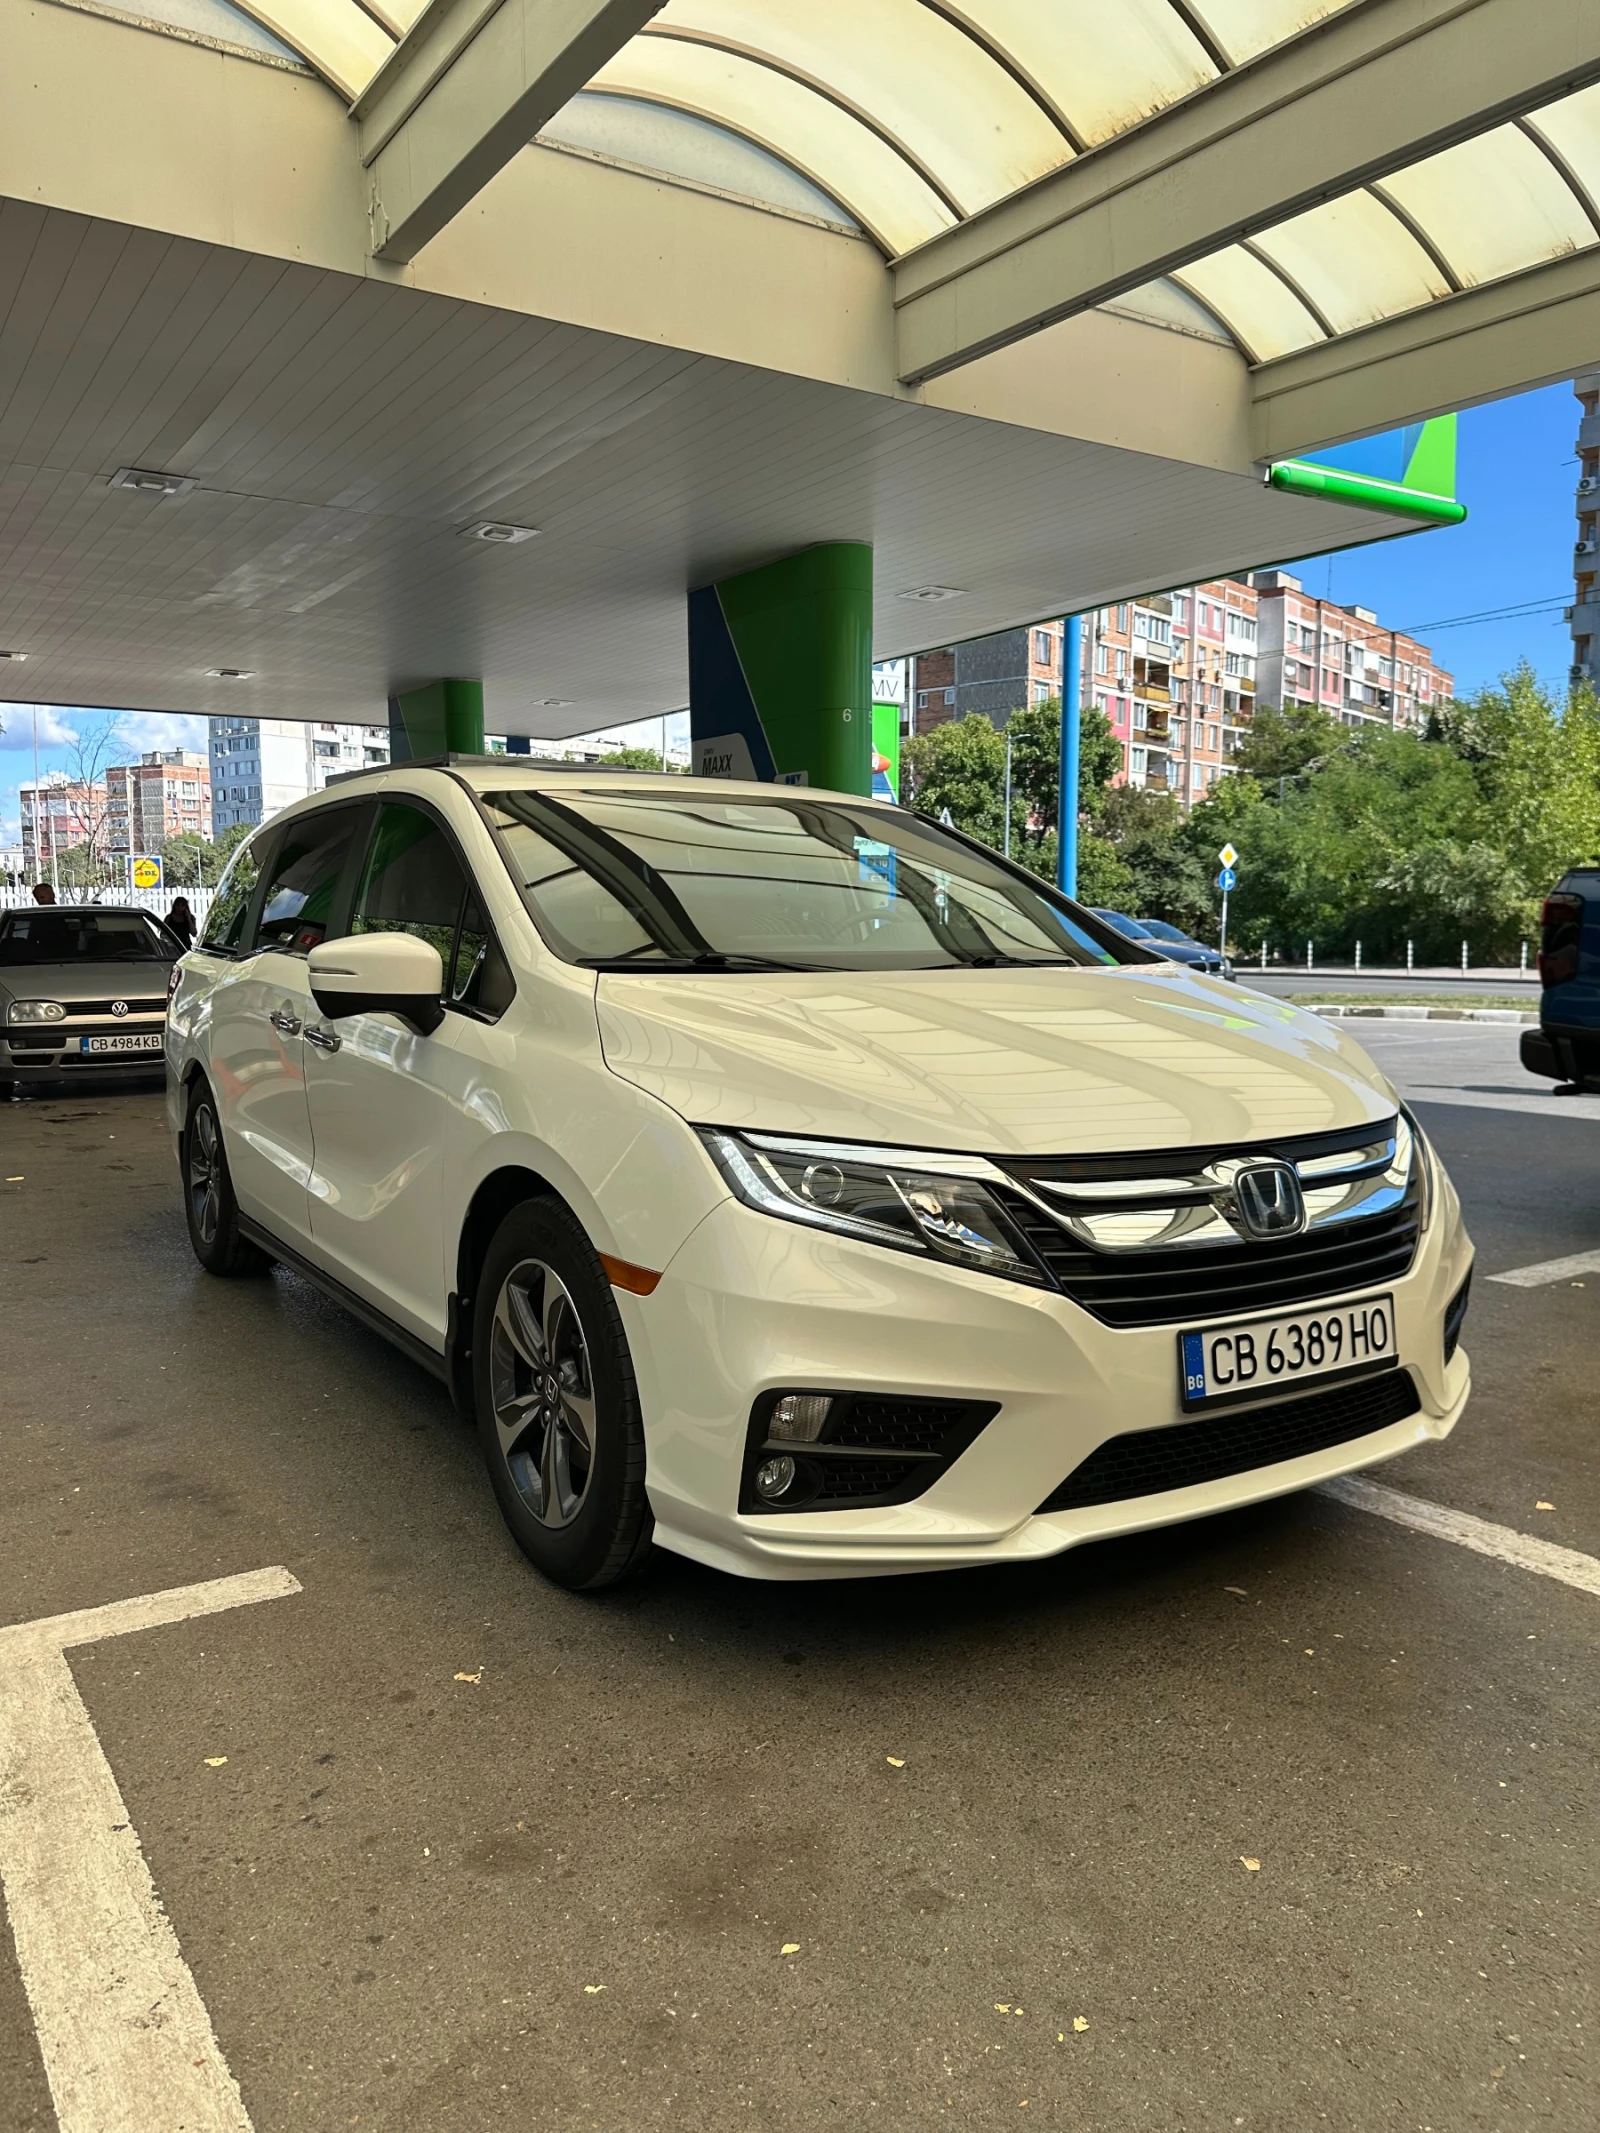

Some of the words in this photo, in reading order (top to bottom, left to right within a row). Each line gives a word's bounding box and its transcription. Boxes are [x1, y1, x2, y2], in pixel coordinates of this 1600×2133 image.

[872, 679, 898, 697] MV
[842, 708, 852, 723] 6
[702, 754, 732, 775] MAXX
[91, 1039, 108, 1051] CB
[111, 1037, 141, 1049] 4984
[143, 1036, 160, 1048] KB
[1211, 1333, 1258, 1385] CB
[1266, 1316, 1343, 1375] 6389
[1348, 1307, 1388, 1358] HO
[1187, 1374, 1204, 1390] BG
